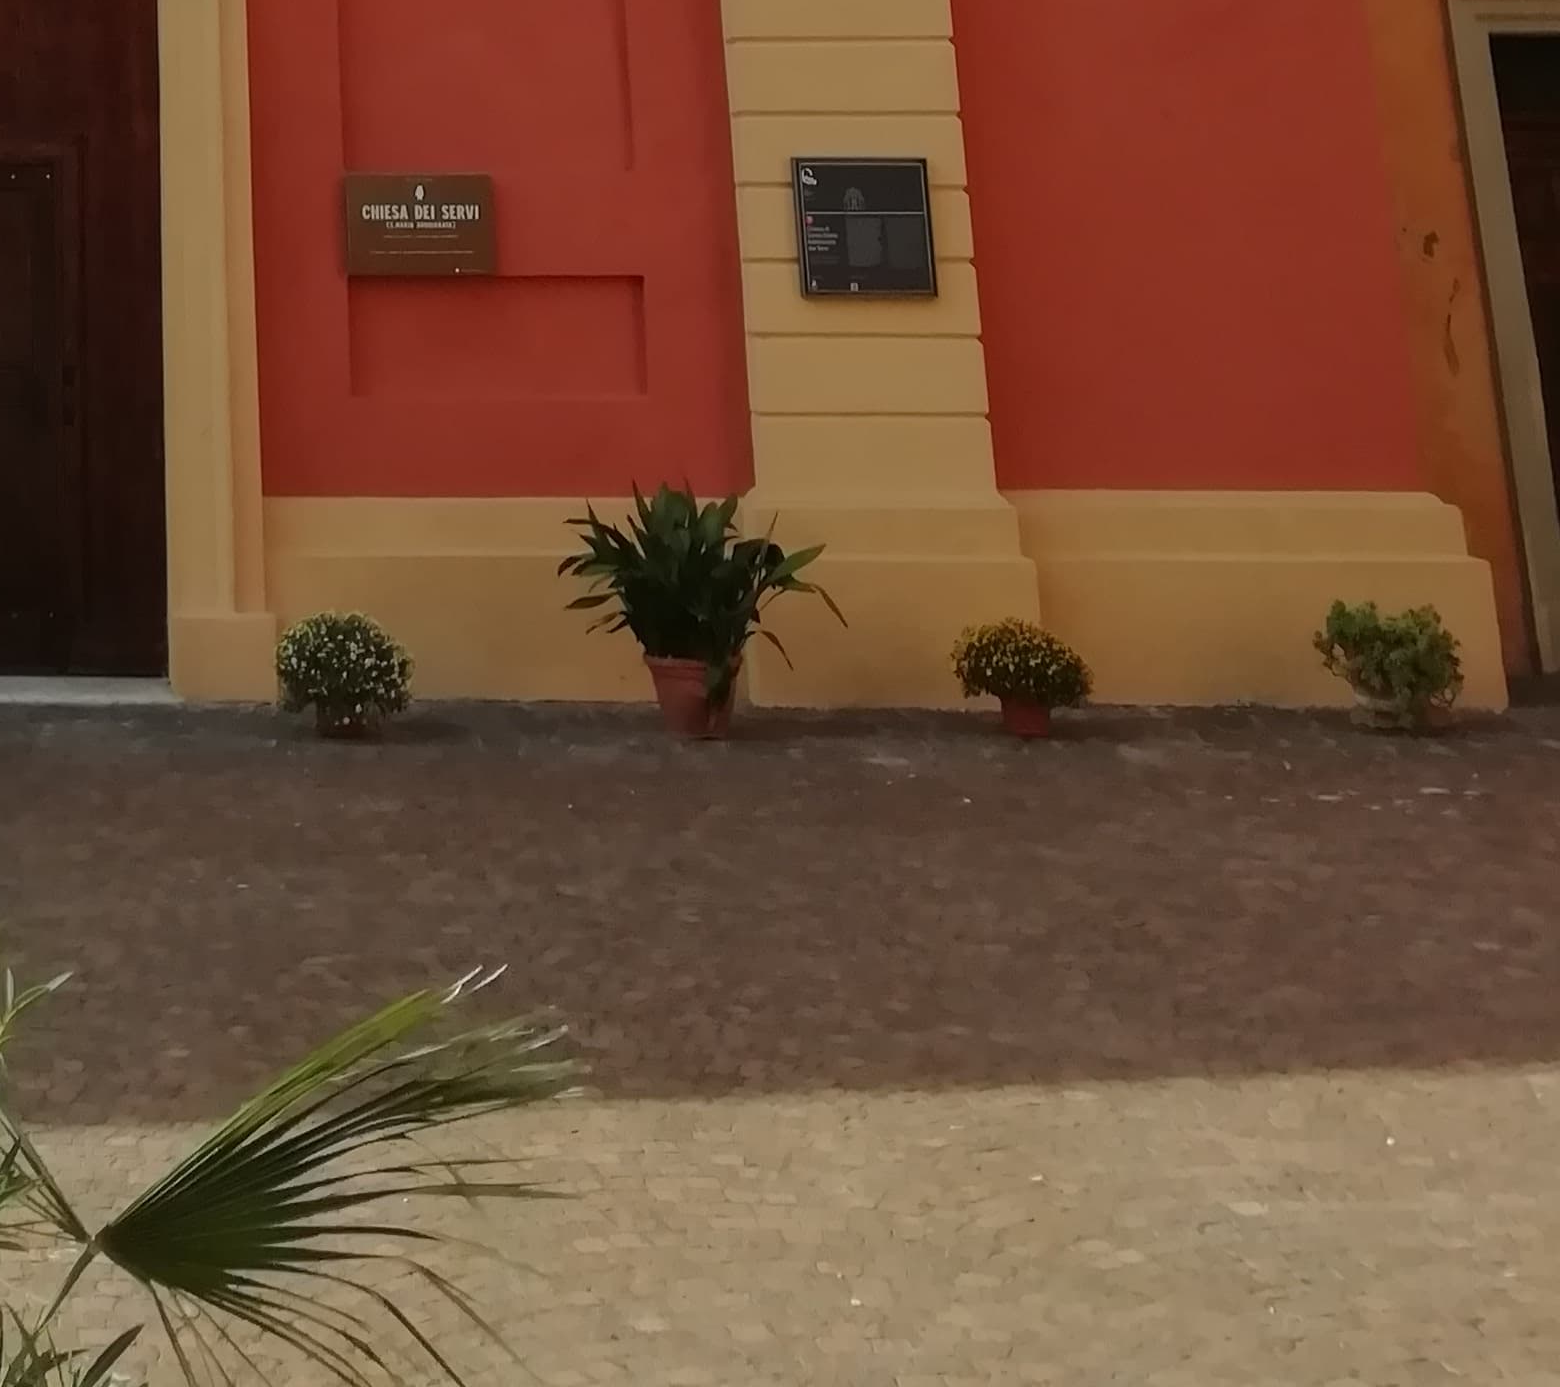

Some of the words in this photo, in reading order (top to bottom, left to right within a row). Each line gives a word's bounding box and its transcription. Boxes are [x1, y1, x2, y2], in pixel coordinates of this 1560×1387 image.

[362, 203, 409, 220] CHIESA
[414, 203, 436, 220] DEI
[441, 203, 481, 220] SERVI
